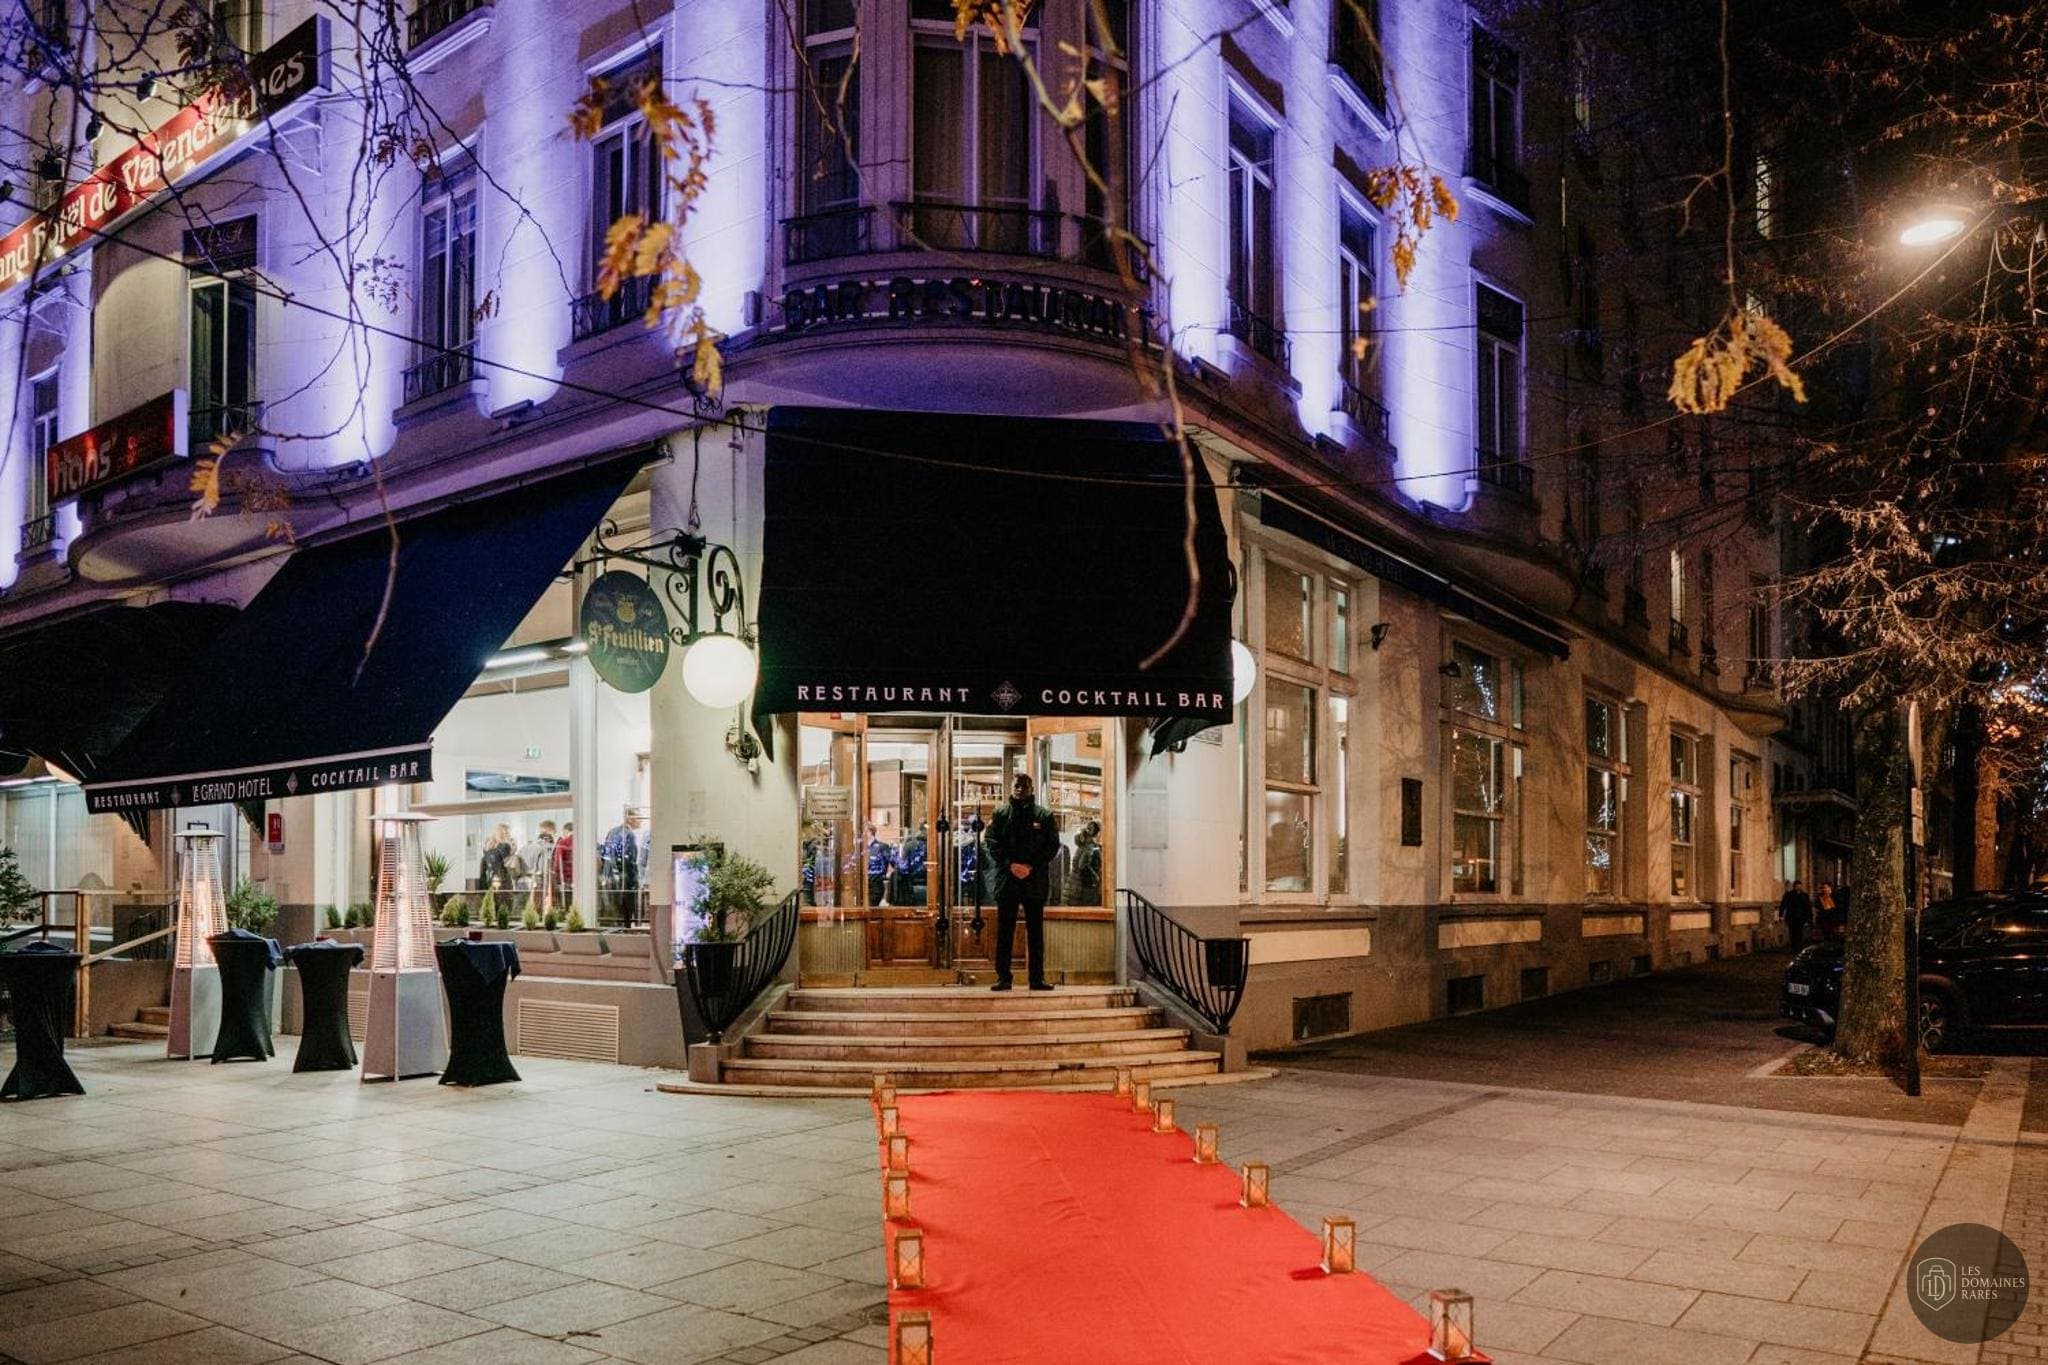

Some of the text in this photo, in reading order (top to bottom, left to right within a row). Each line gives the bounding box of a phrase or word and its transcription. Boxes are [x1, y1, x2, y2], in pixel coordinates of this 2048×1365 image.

[89, 182, 117, 221] de
[798, 686, 969, 702] RESTAURANT
[1041, 689, 1224, 709] COCKTAIL BAR
[311, 761, 419, 788] COCKTAIL BAR
[94, 791, 160, 809] RESTAURANT
[200, 782, 236, 801] GRAND
[238, 777, 273, 799] HOTEL
